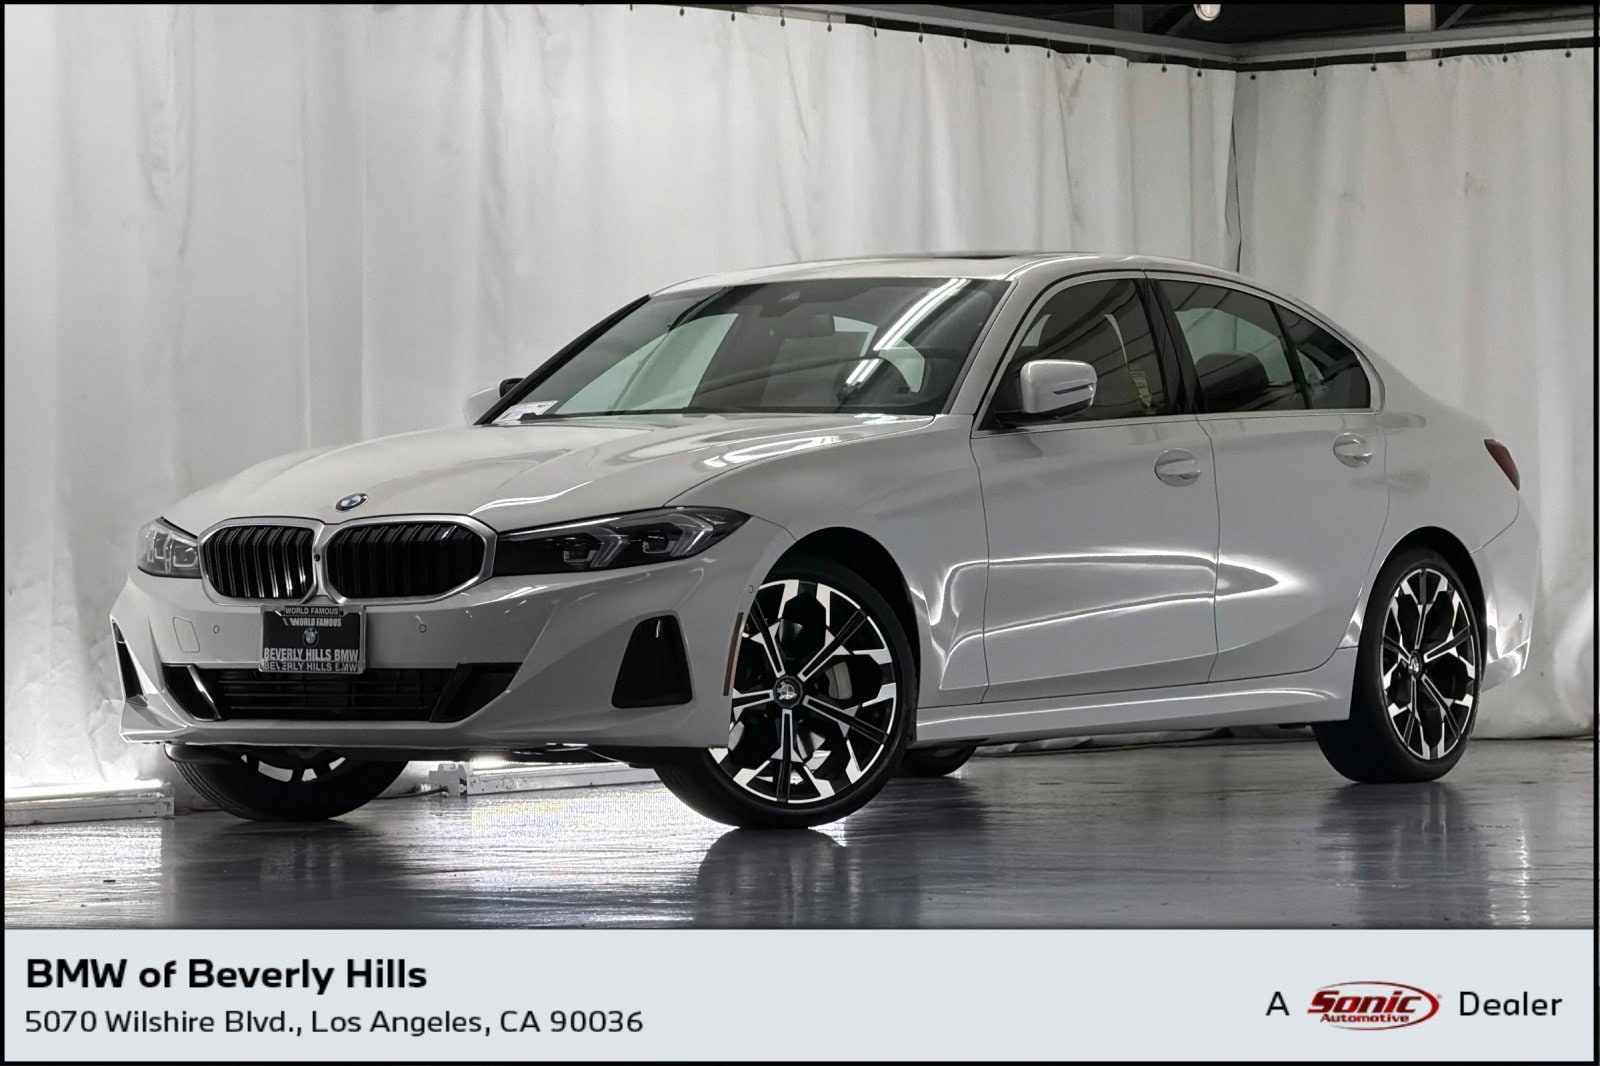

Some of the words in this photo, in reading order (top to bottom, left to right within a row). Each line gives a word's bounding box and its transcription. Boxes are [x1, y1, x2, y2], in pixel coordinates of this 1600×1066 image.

[285, 607, 309, 615] WORLD
[310, 607, 339, 615] FAMOUS
[290, 617, 315, 626] WORLD
[316, 617, 342, 627] FAMOUS
[264, 647, 303, 661] BEVERLY
[305, 648, 332, 661] HILLS
[334, 649, 358, 662] BMW
[306, 661, 332, 672] HILLS
